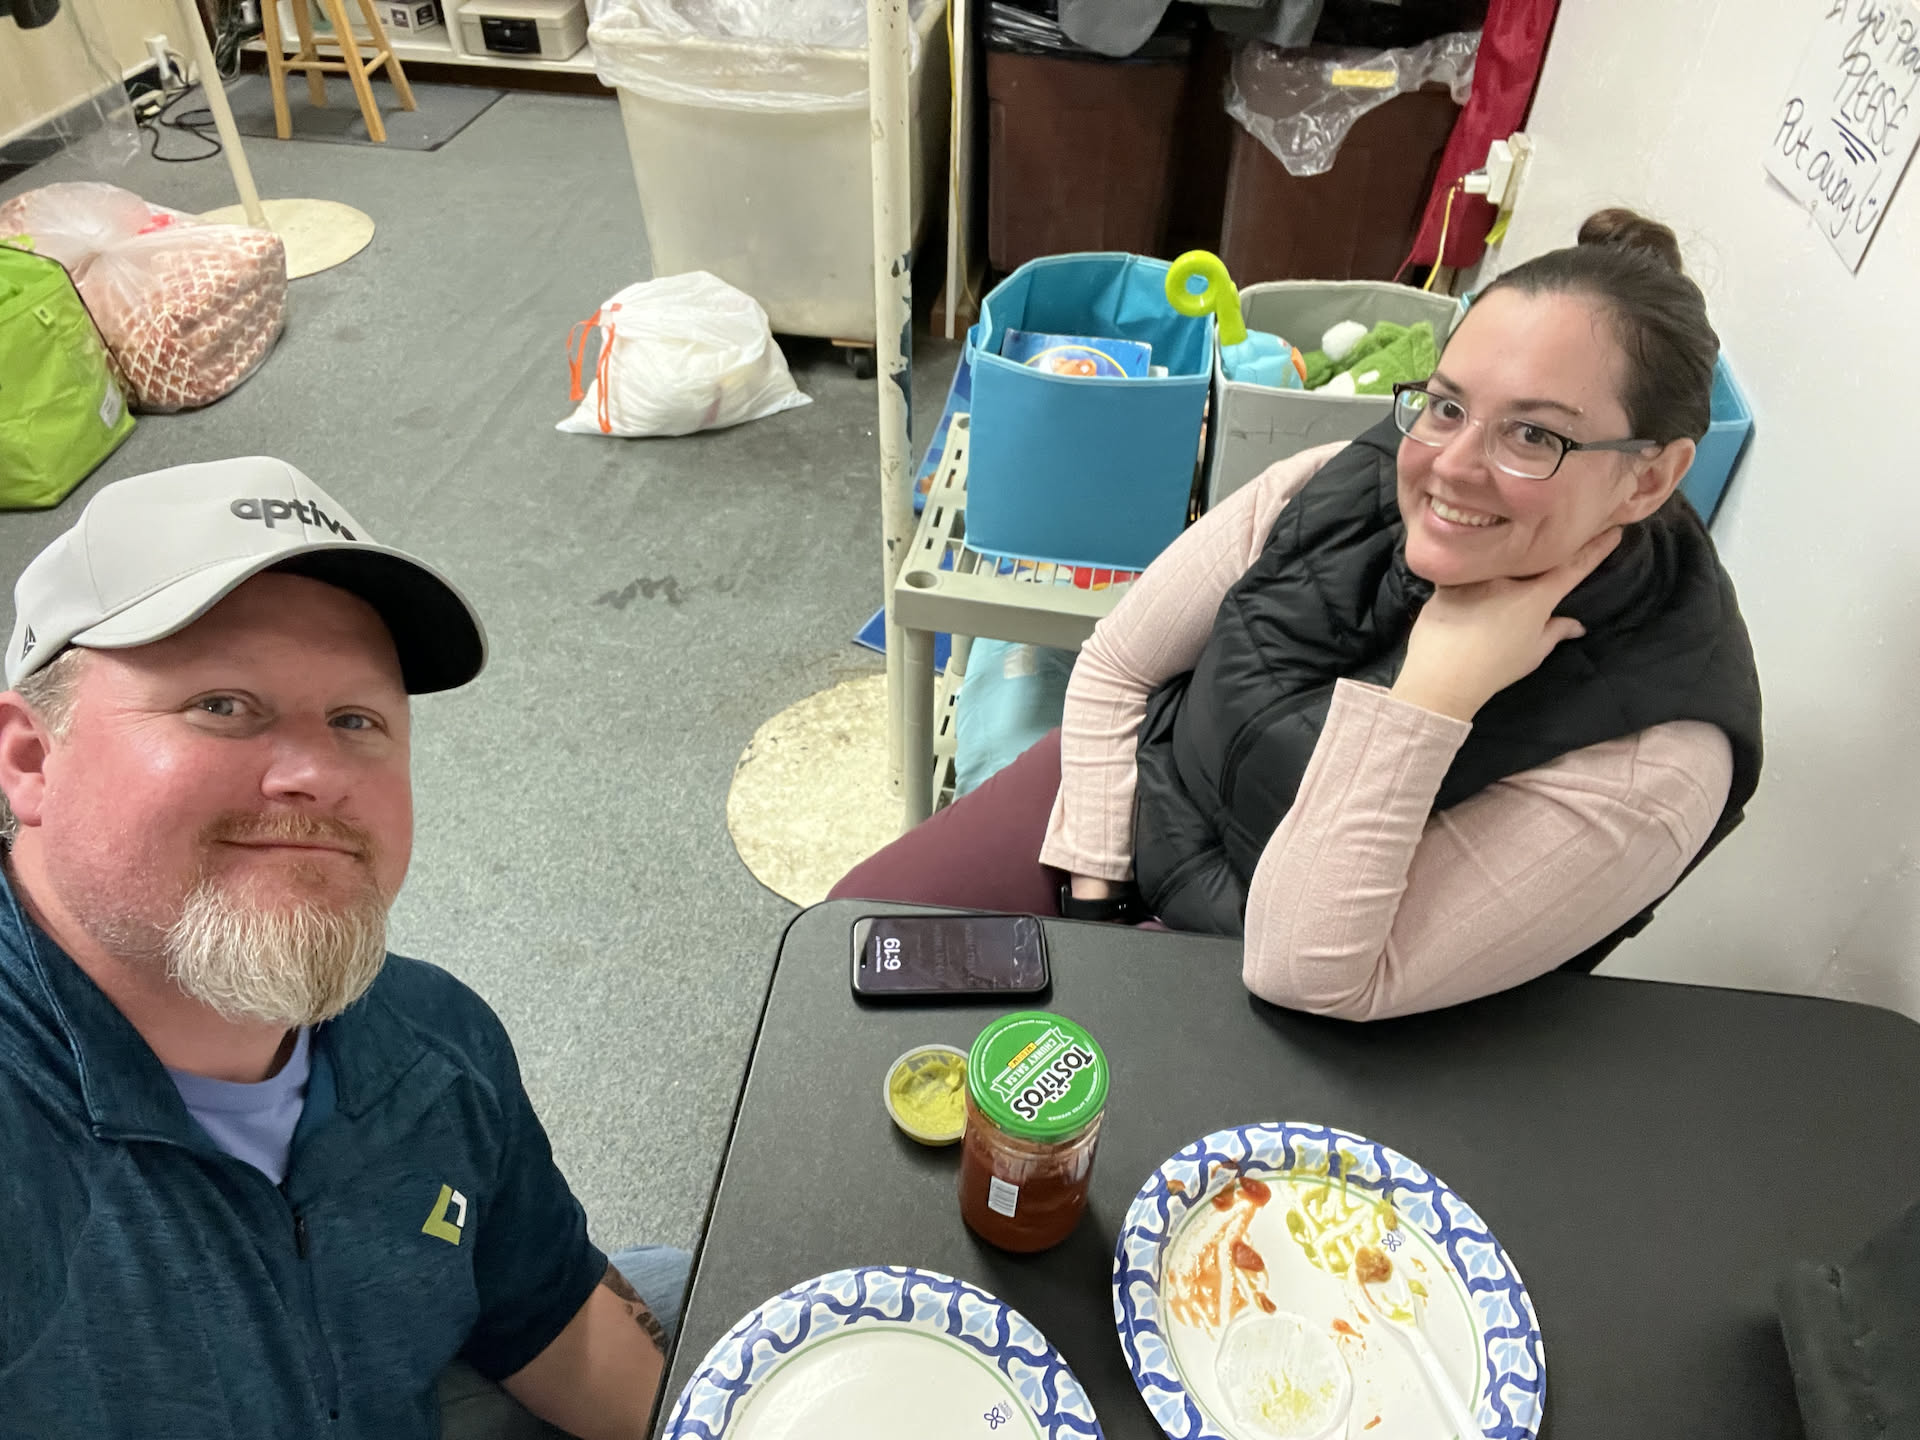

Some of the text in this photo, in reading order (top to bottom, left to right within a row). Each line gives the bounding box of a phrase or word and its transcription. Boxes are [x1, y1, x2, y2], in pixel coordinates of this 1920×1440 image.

[1834, 52, 1908, 156] PLEASE
[1774, 98, 1812, 170] Put
[884, 937, 902, 970] 6:19
[1027, 1038, 1057, 1066] CHUNKY
[1004, 1062, 1030, 1087] SALSA
